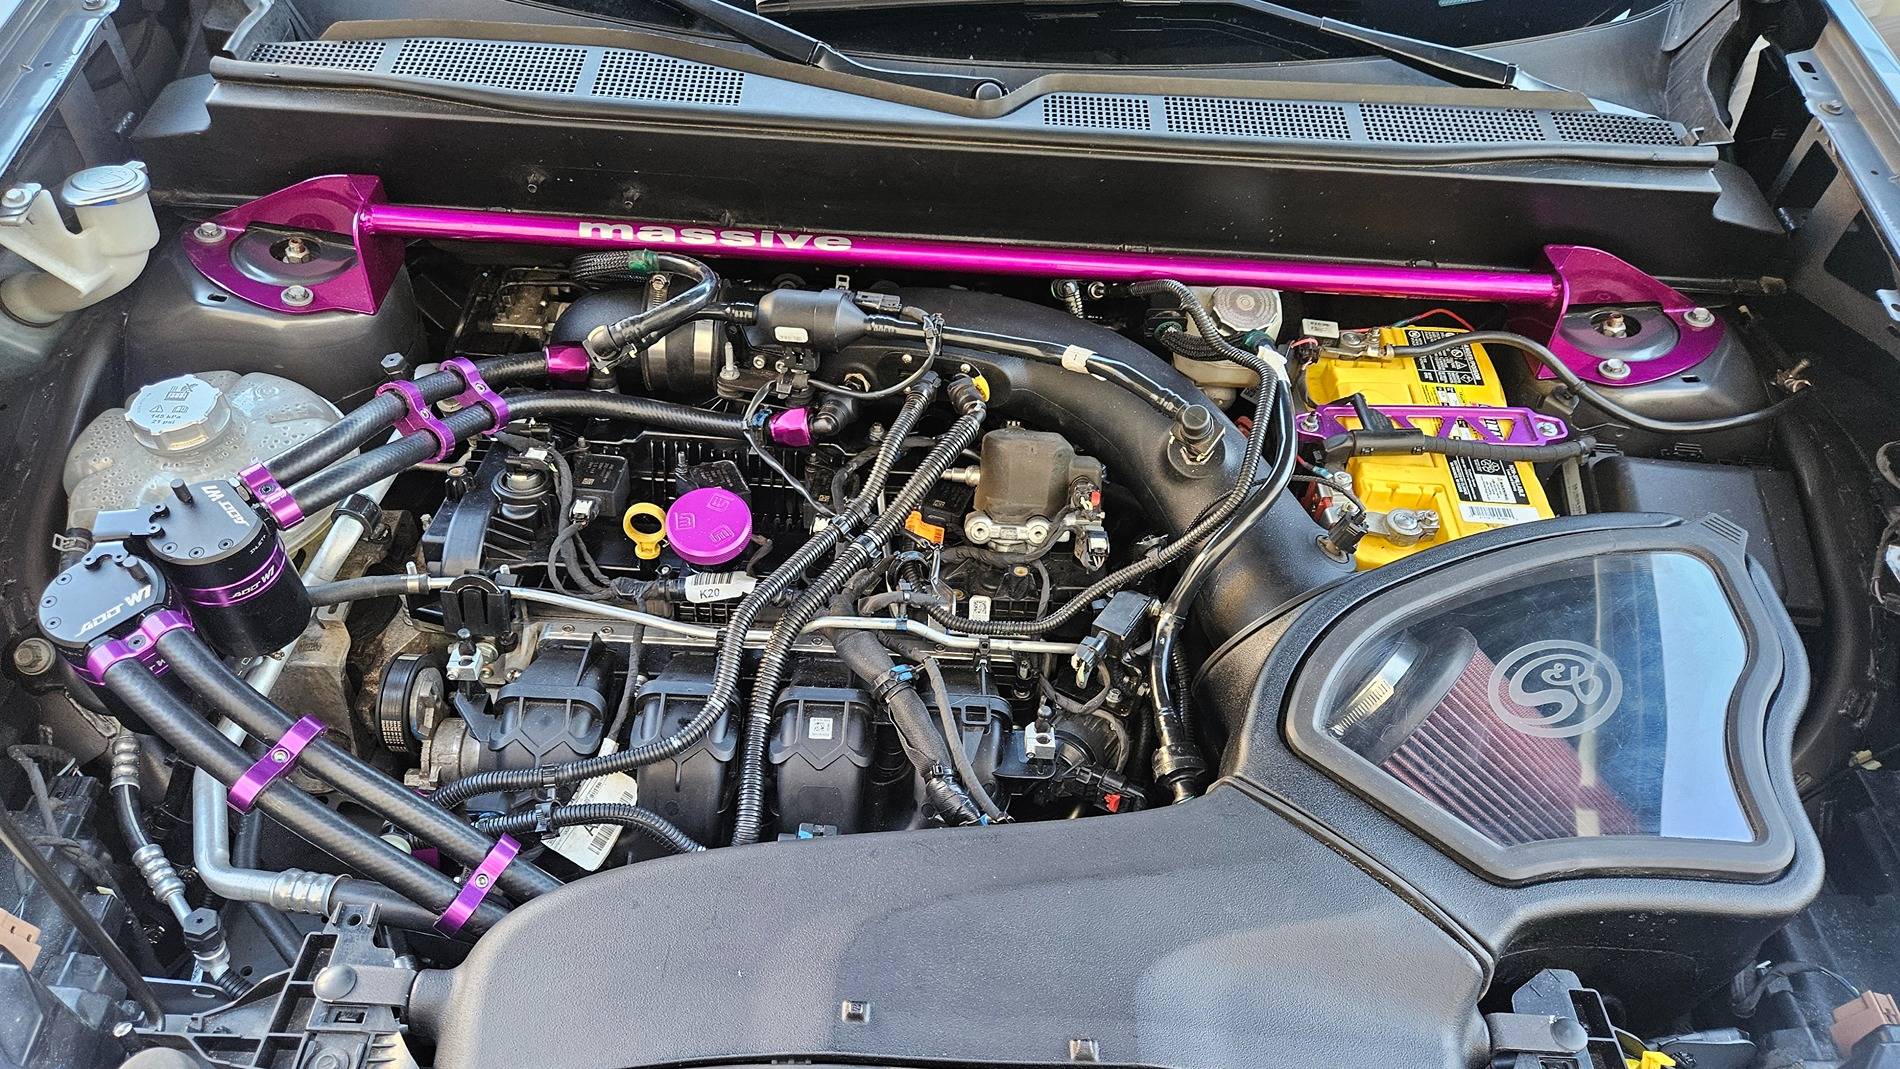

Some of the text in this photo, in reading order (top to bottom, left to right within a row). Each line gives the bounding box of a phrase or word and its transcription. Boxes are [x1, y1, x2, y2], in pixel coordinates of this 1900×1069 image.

[579, 221, 852, 251] massive
[699, 587, 720, 599] K20
[1509, 653, 1604, 726] S&B
